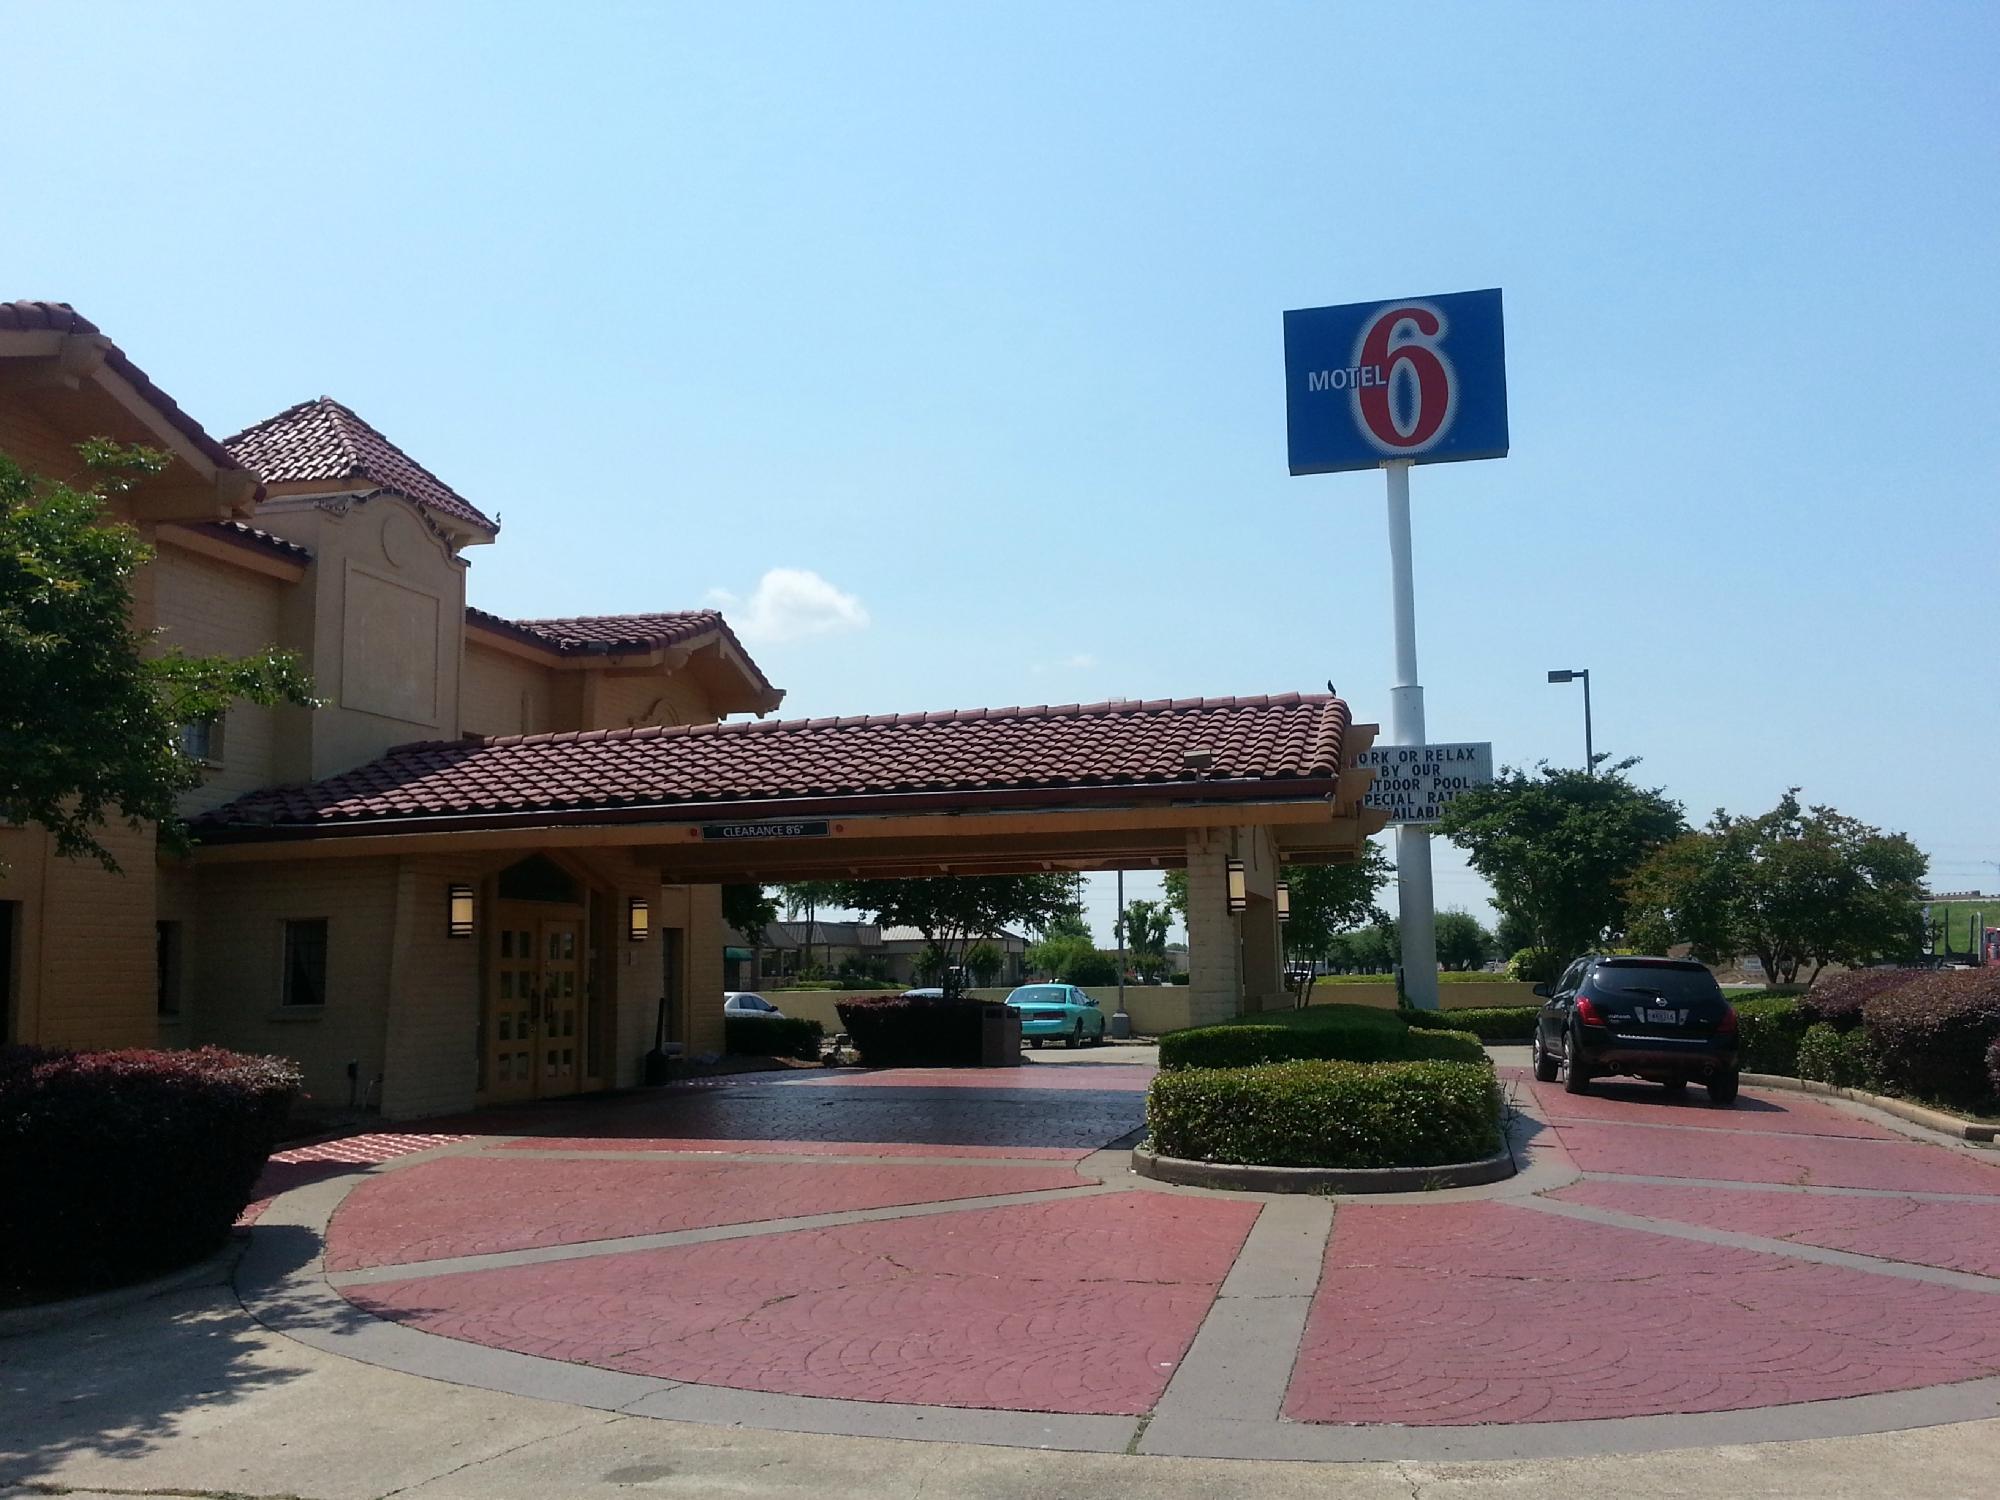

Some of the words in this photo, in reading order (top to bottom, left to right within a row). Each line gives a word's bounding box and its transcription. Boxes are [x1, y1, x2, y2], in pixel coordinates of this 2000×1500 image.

[1308, 365, 1387, 392] MOTEL
[1358, 307, 1450, 448] 6
[1358, 751, 1390, 764] ORK
[1399, 750, 1418, 763] OR
[1425, 748, 1475, 761] RELAX
[1381, 764, 1400, 777] BY
[1411, 763, 1441, 776] OUR
[1368, 778, 1420, 792] UTDOOR
[1433, 777, 1471, 790] POOL
[1364, 793, 1415, 806] PECIAL
[1427, 791, 1459, 804] RAT
[1391, 806, 1451, 819] AILABL
[723, 825, 784, 837] CLEARANCE
